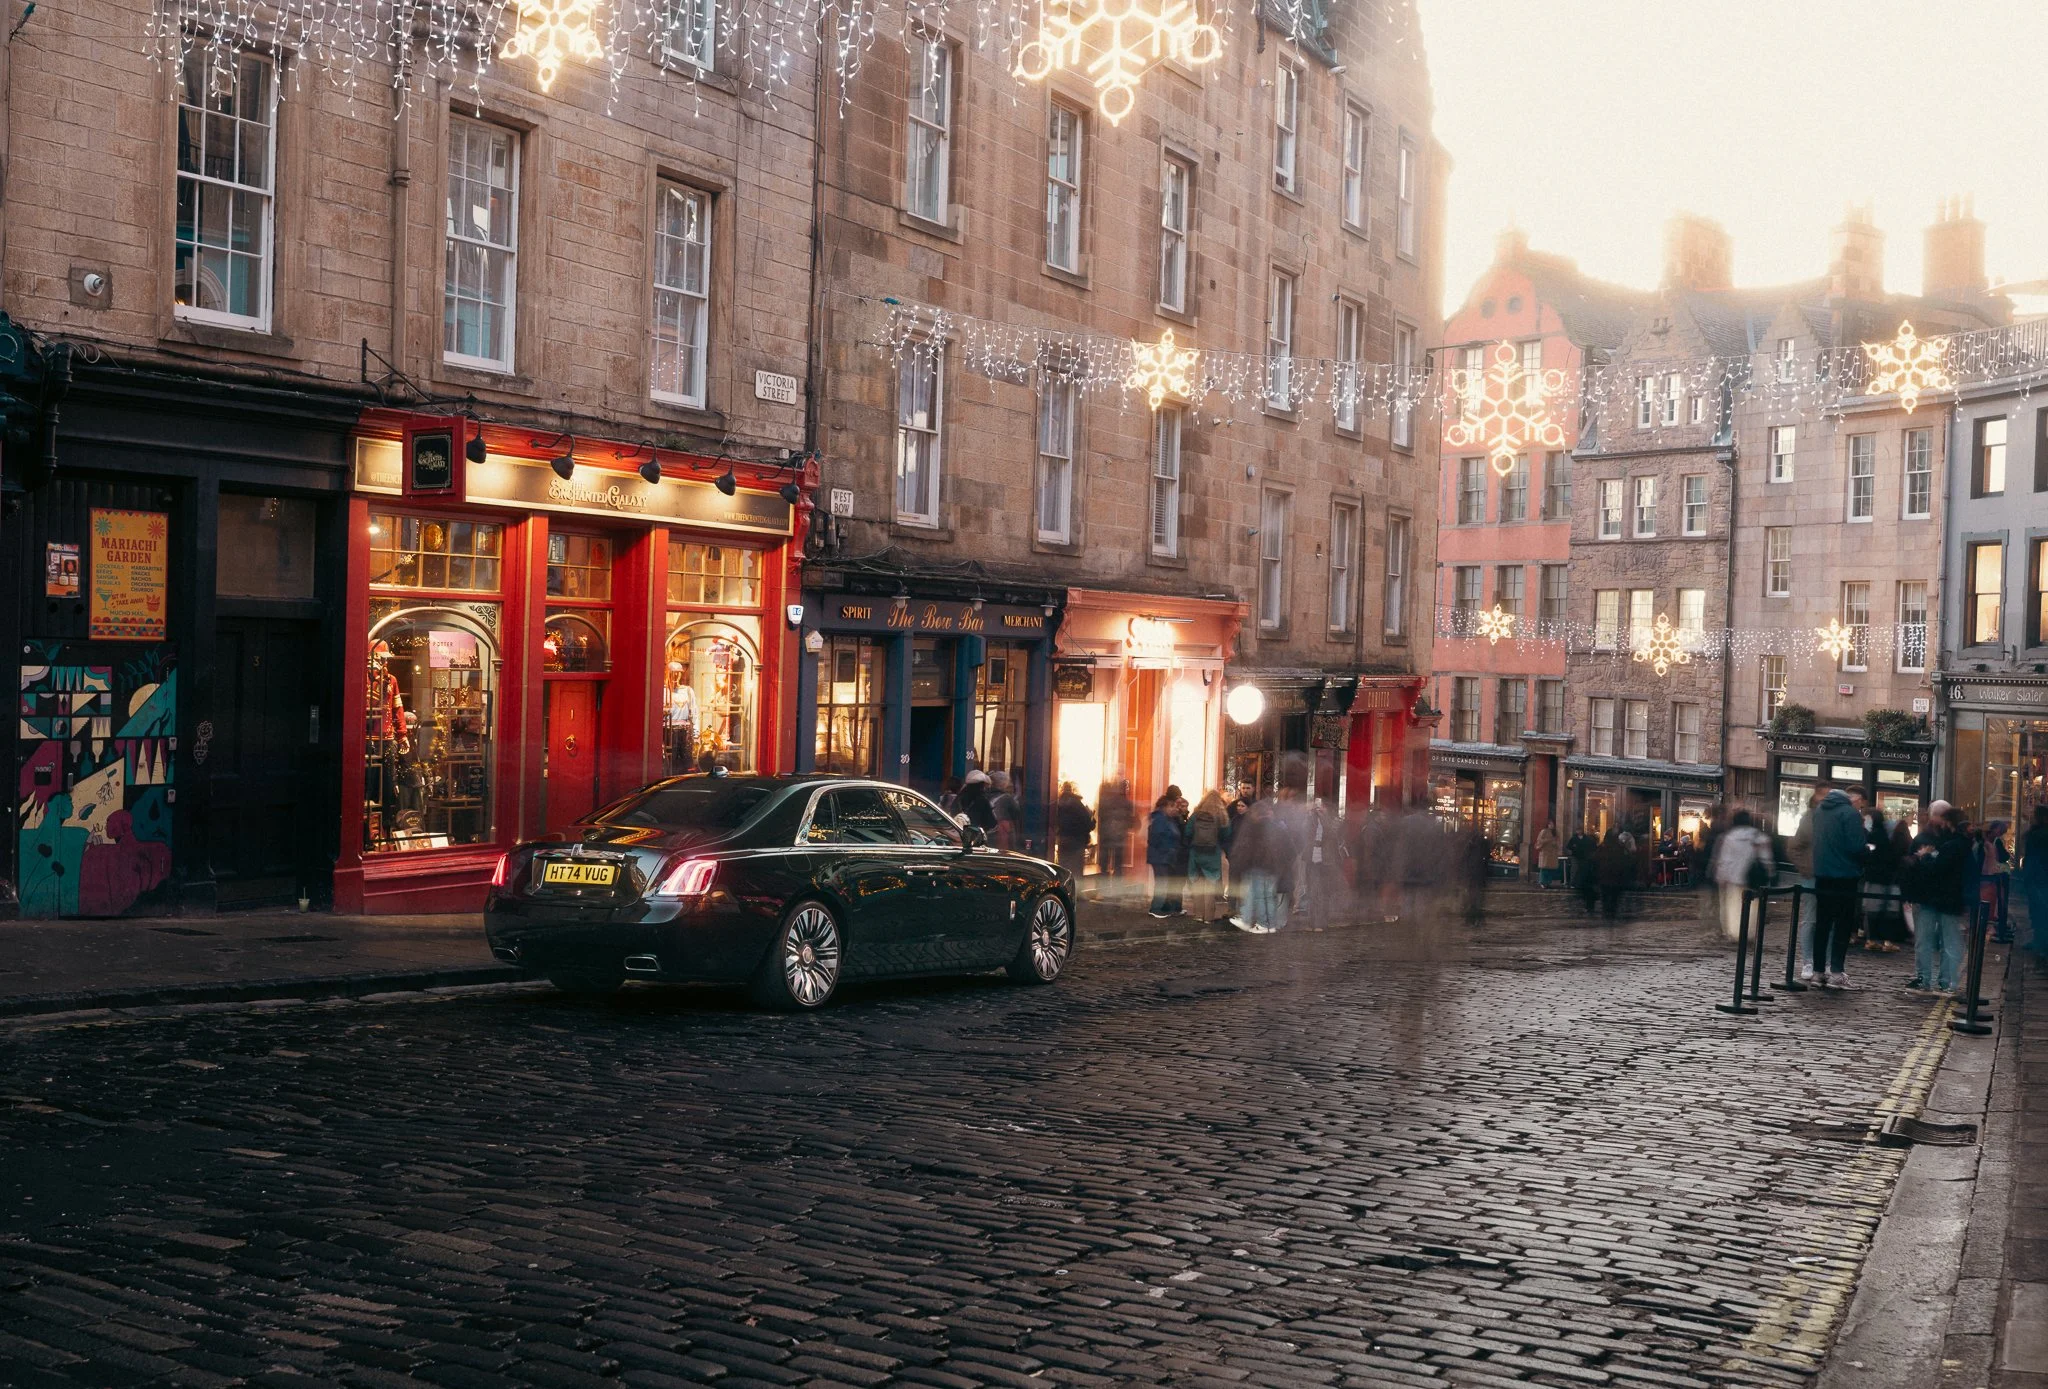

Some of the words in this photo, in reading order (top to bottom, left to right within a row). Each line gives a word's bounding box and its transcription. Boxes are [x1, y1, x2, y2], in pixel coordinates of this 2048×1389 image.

[758, 373, 794, 390] VICTORIA
[763, 386, 790, 401] STREET
[548, 479, 608, 507] ENCHANTED
[607, 485, 649, 510] GALAXY
[833, 490, 851, 500] WEST
[834, 502, 850, 514] BOW
[101, 537, 157, 552] MARIACHI
[106, 550, 151, 564] GARDEN
[842, 606, 872, 619] SPIRIT
[888, 603, 915, 628] The
[921, 604, 953, 629] Bow
[958, 607, 984, 631] Bar
[1004, 615, 1044, 627] MERCHANT
[1979, 688, 2012, 701] Walker
[2016, 688, 2044, 702] Slater
[1456, 757, 1479, 765] CANDLE
[1880, 751, 1911, 760] CLARKSONS
[550, 866, 581, 880] HT74
[585, 867, 608, 881] VUG
